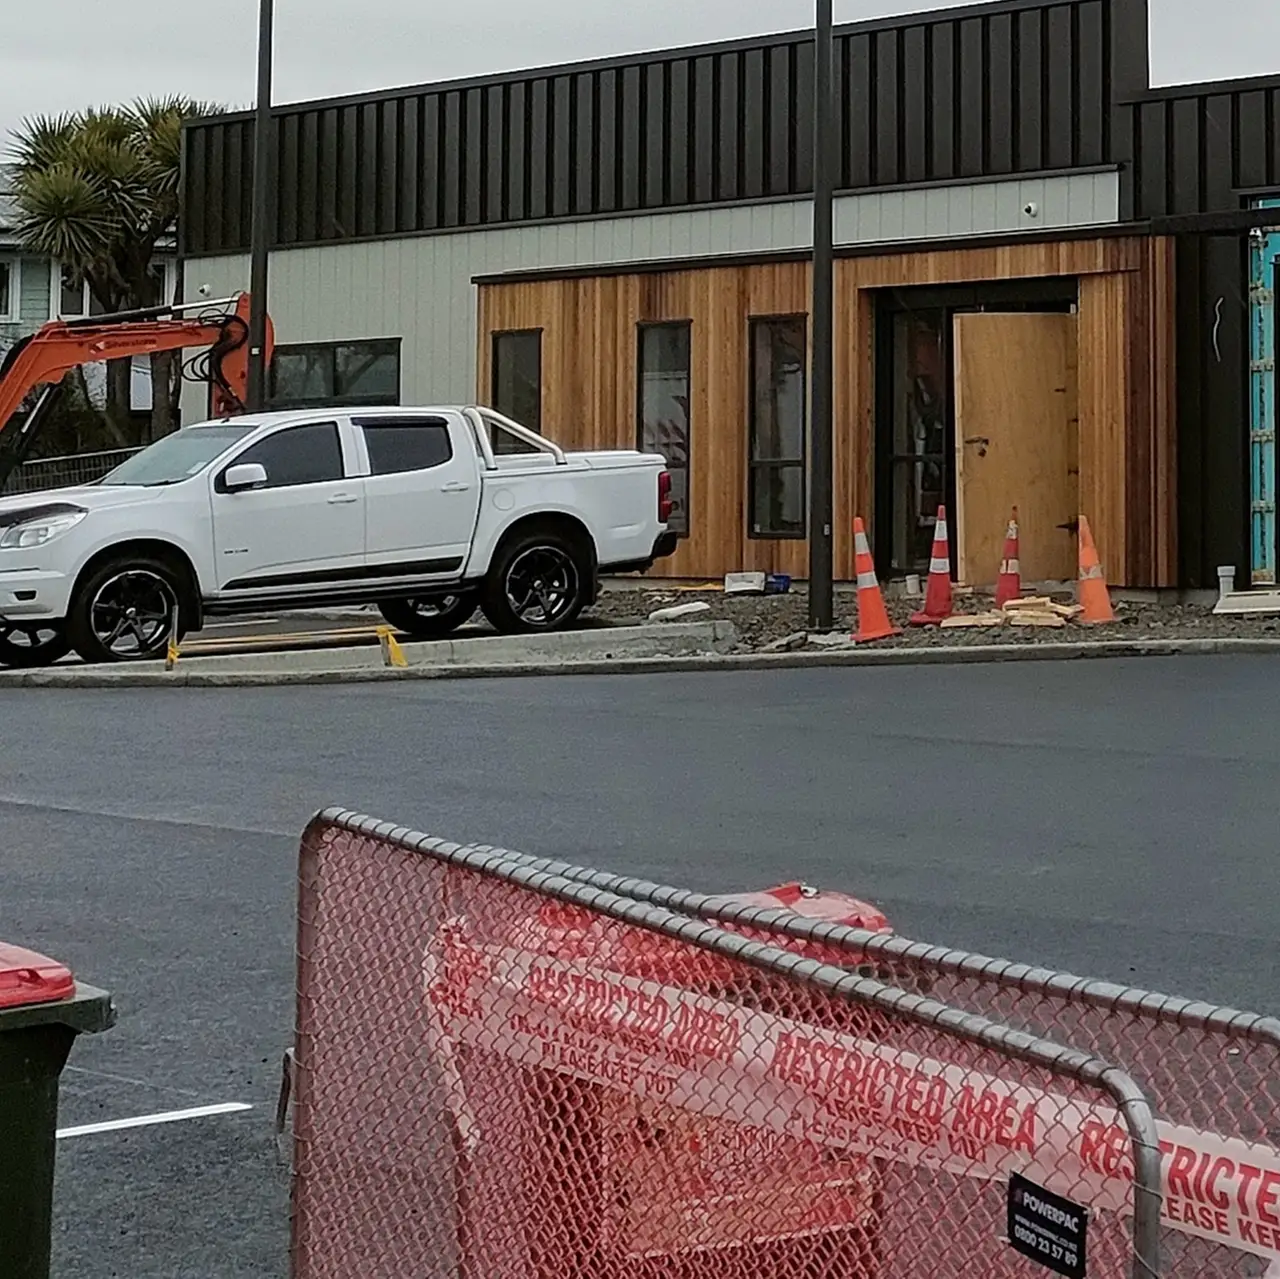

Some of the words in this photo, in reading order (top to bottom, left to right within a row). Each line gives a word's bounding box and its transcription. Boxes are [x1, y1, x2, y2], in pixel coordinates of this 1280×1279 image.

[771, 1032, 947, 1124] RESTRICTED
[953, 1083, 1037, 1152] AREA
[1023, 1191, 1079, 1233] POWERPAC
[1014, 1224, 1037, 1247] 0800
